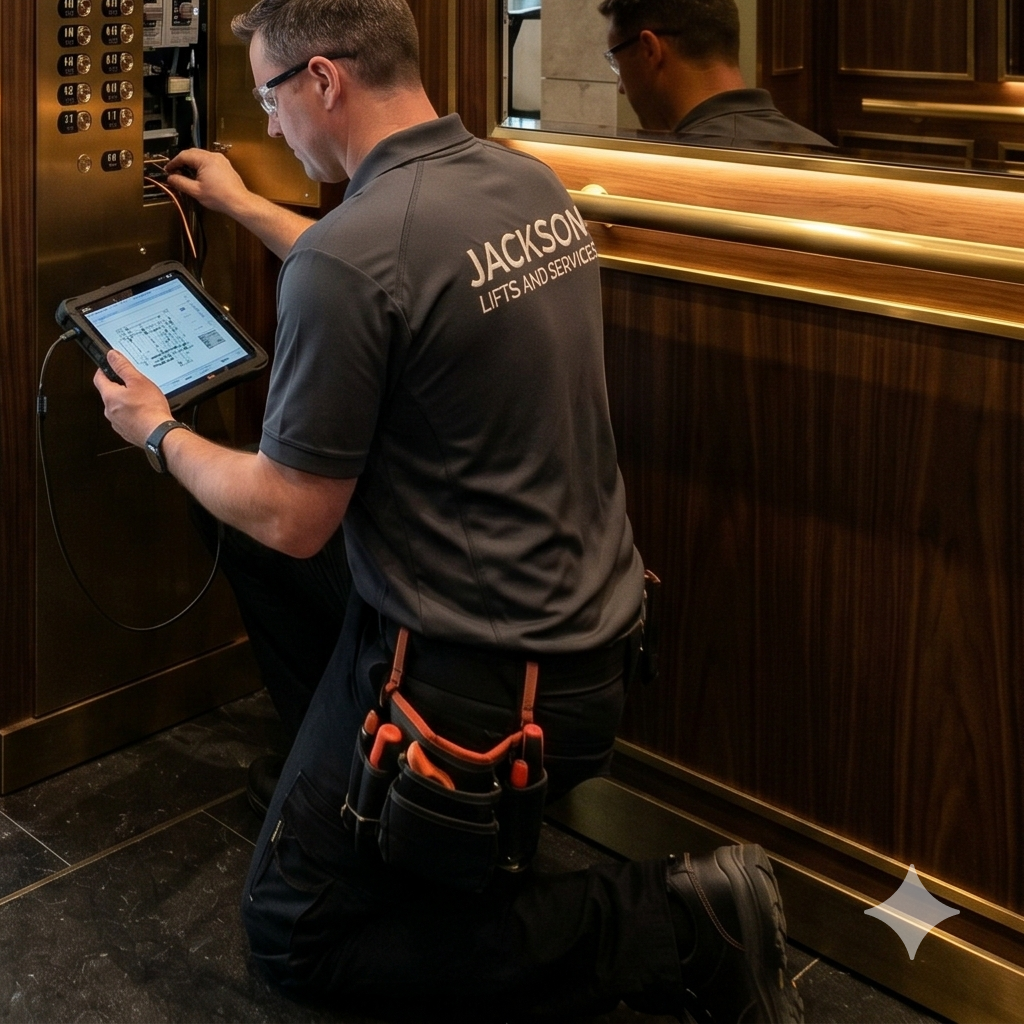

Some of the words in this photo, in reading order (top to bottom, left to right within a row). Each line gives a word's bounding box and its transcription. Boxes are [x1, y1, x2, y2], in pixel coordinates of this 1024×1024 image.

[466, 205, 588, 288] JACKSON
[479, 280, 521, 314] LIFTS
[523, 267, 549, 294] AND
[548, 241, 597, 280] SERVICES
